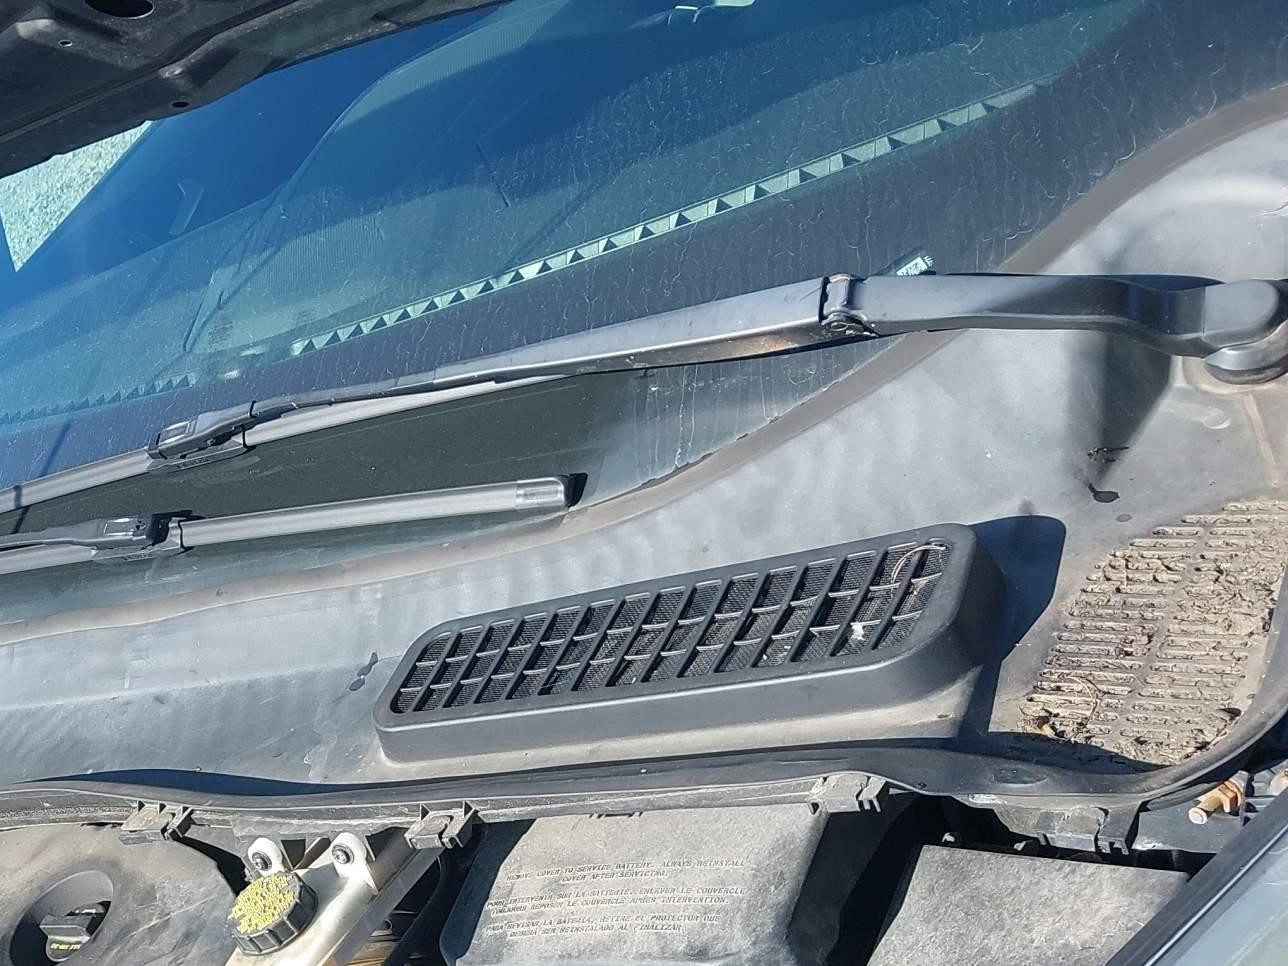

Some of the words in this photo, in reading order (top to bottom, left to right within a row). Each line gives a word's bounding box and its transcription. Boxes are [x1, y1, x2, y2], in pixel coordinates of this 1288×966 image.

[536, 868, 560, 877] COVER
[577, 864, 610, 872] SERVICE
[561, 873, 587, 883] COVER
[589, 872, 616, 880] AFTER
[696, 887, 747, 895] COUVERCLE
